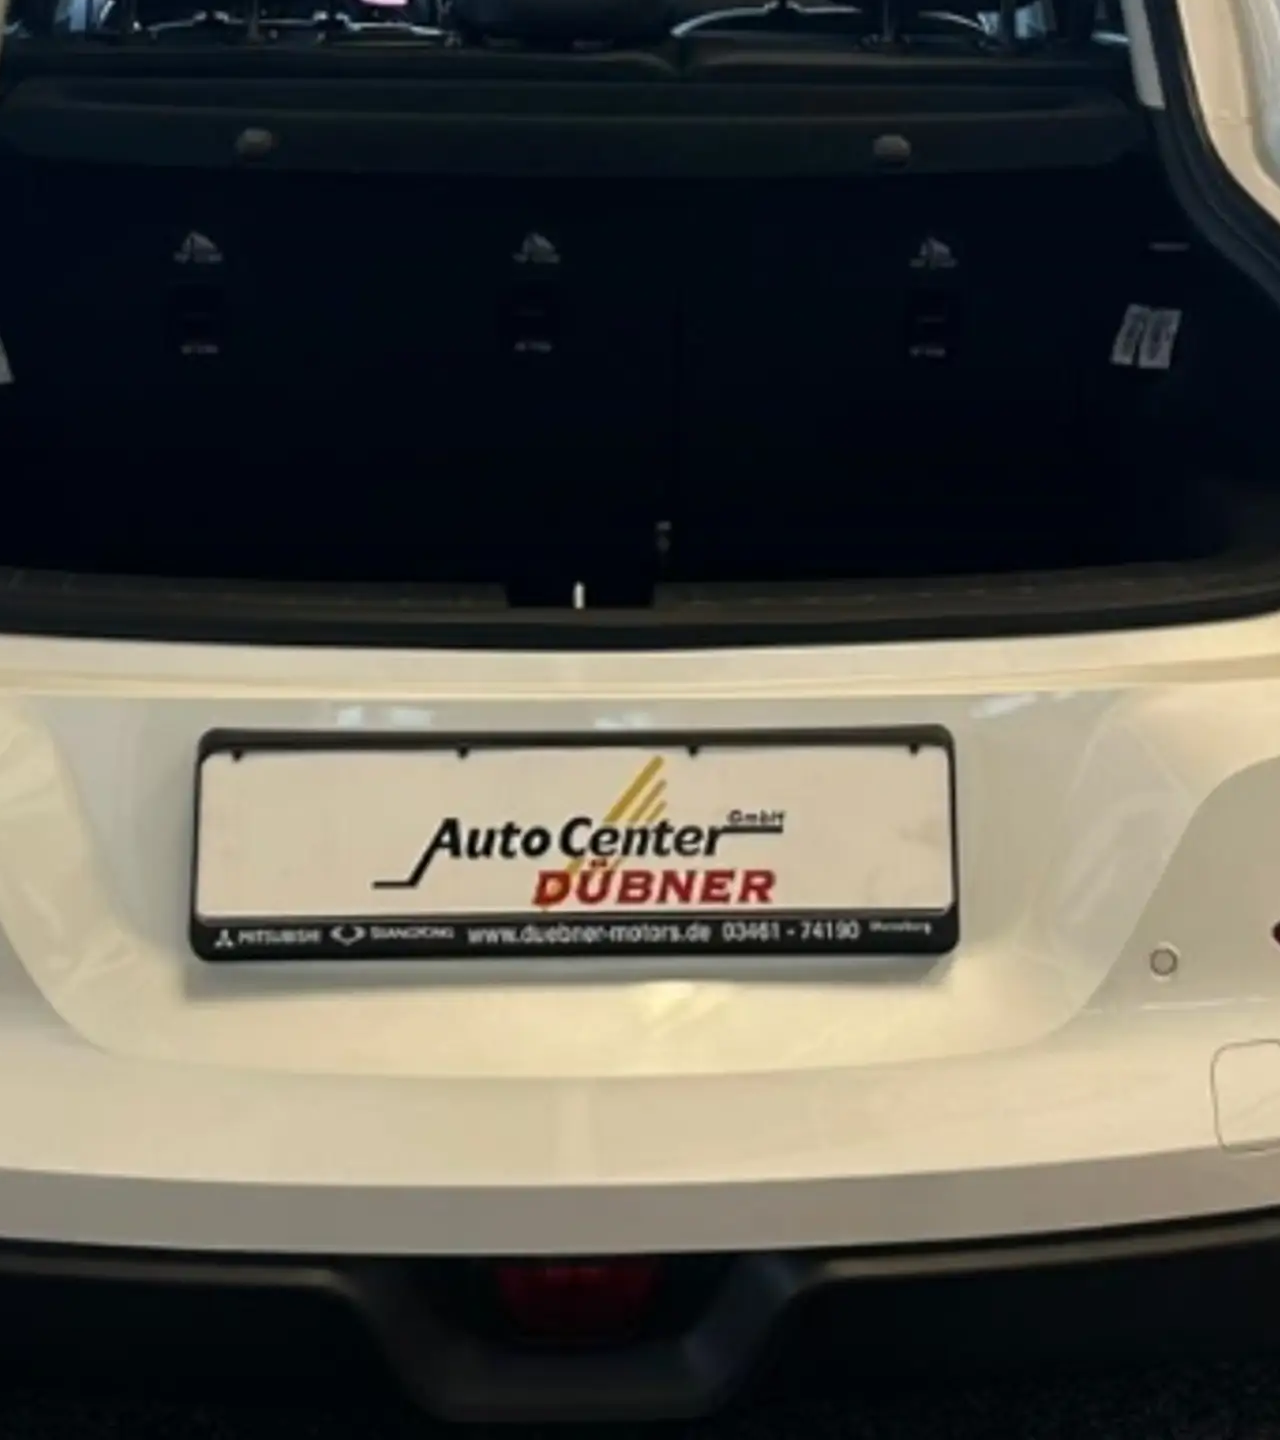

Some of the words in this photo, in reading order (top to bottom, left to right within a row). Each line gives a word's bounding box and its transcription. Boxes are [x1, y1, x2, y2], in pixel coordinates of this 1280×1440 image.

[426, 817, 552, 859] Auto
[559, 816, 724, 859] Center
[726, 809, 786, 826] GmbH
[531, 859, 777, 906] DÜBNER
[468, 922, 712, 945] www.duebner-motors.de
[722, 921, 781, 943] 03461
[801, 920, 861, 941] 74190
